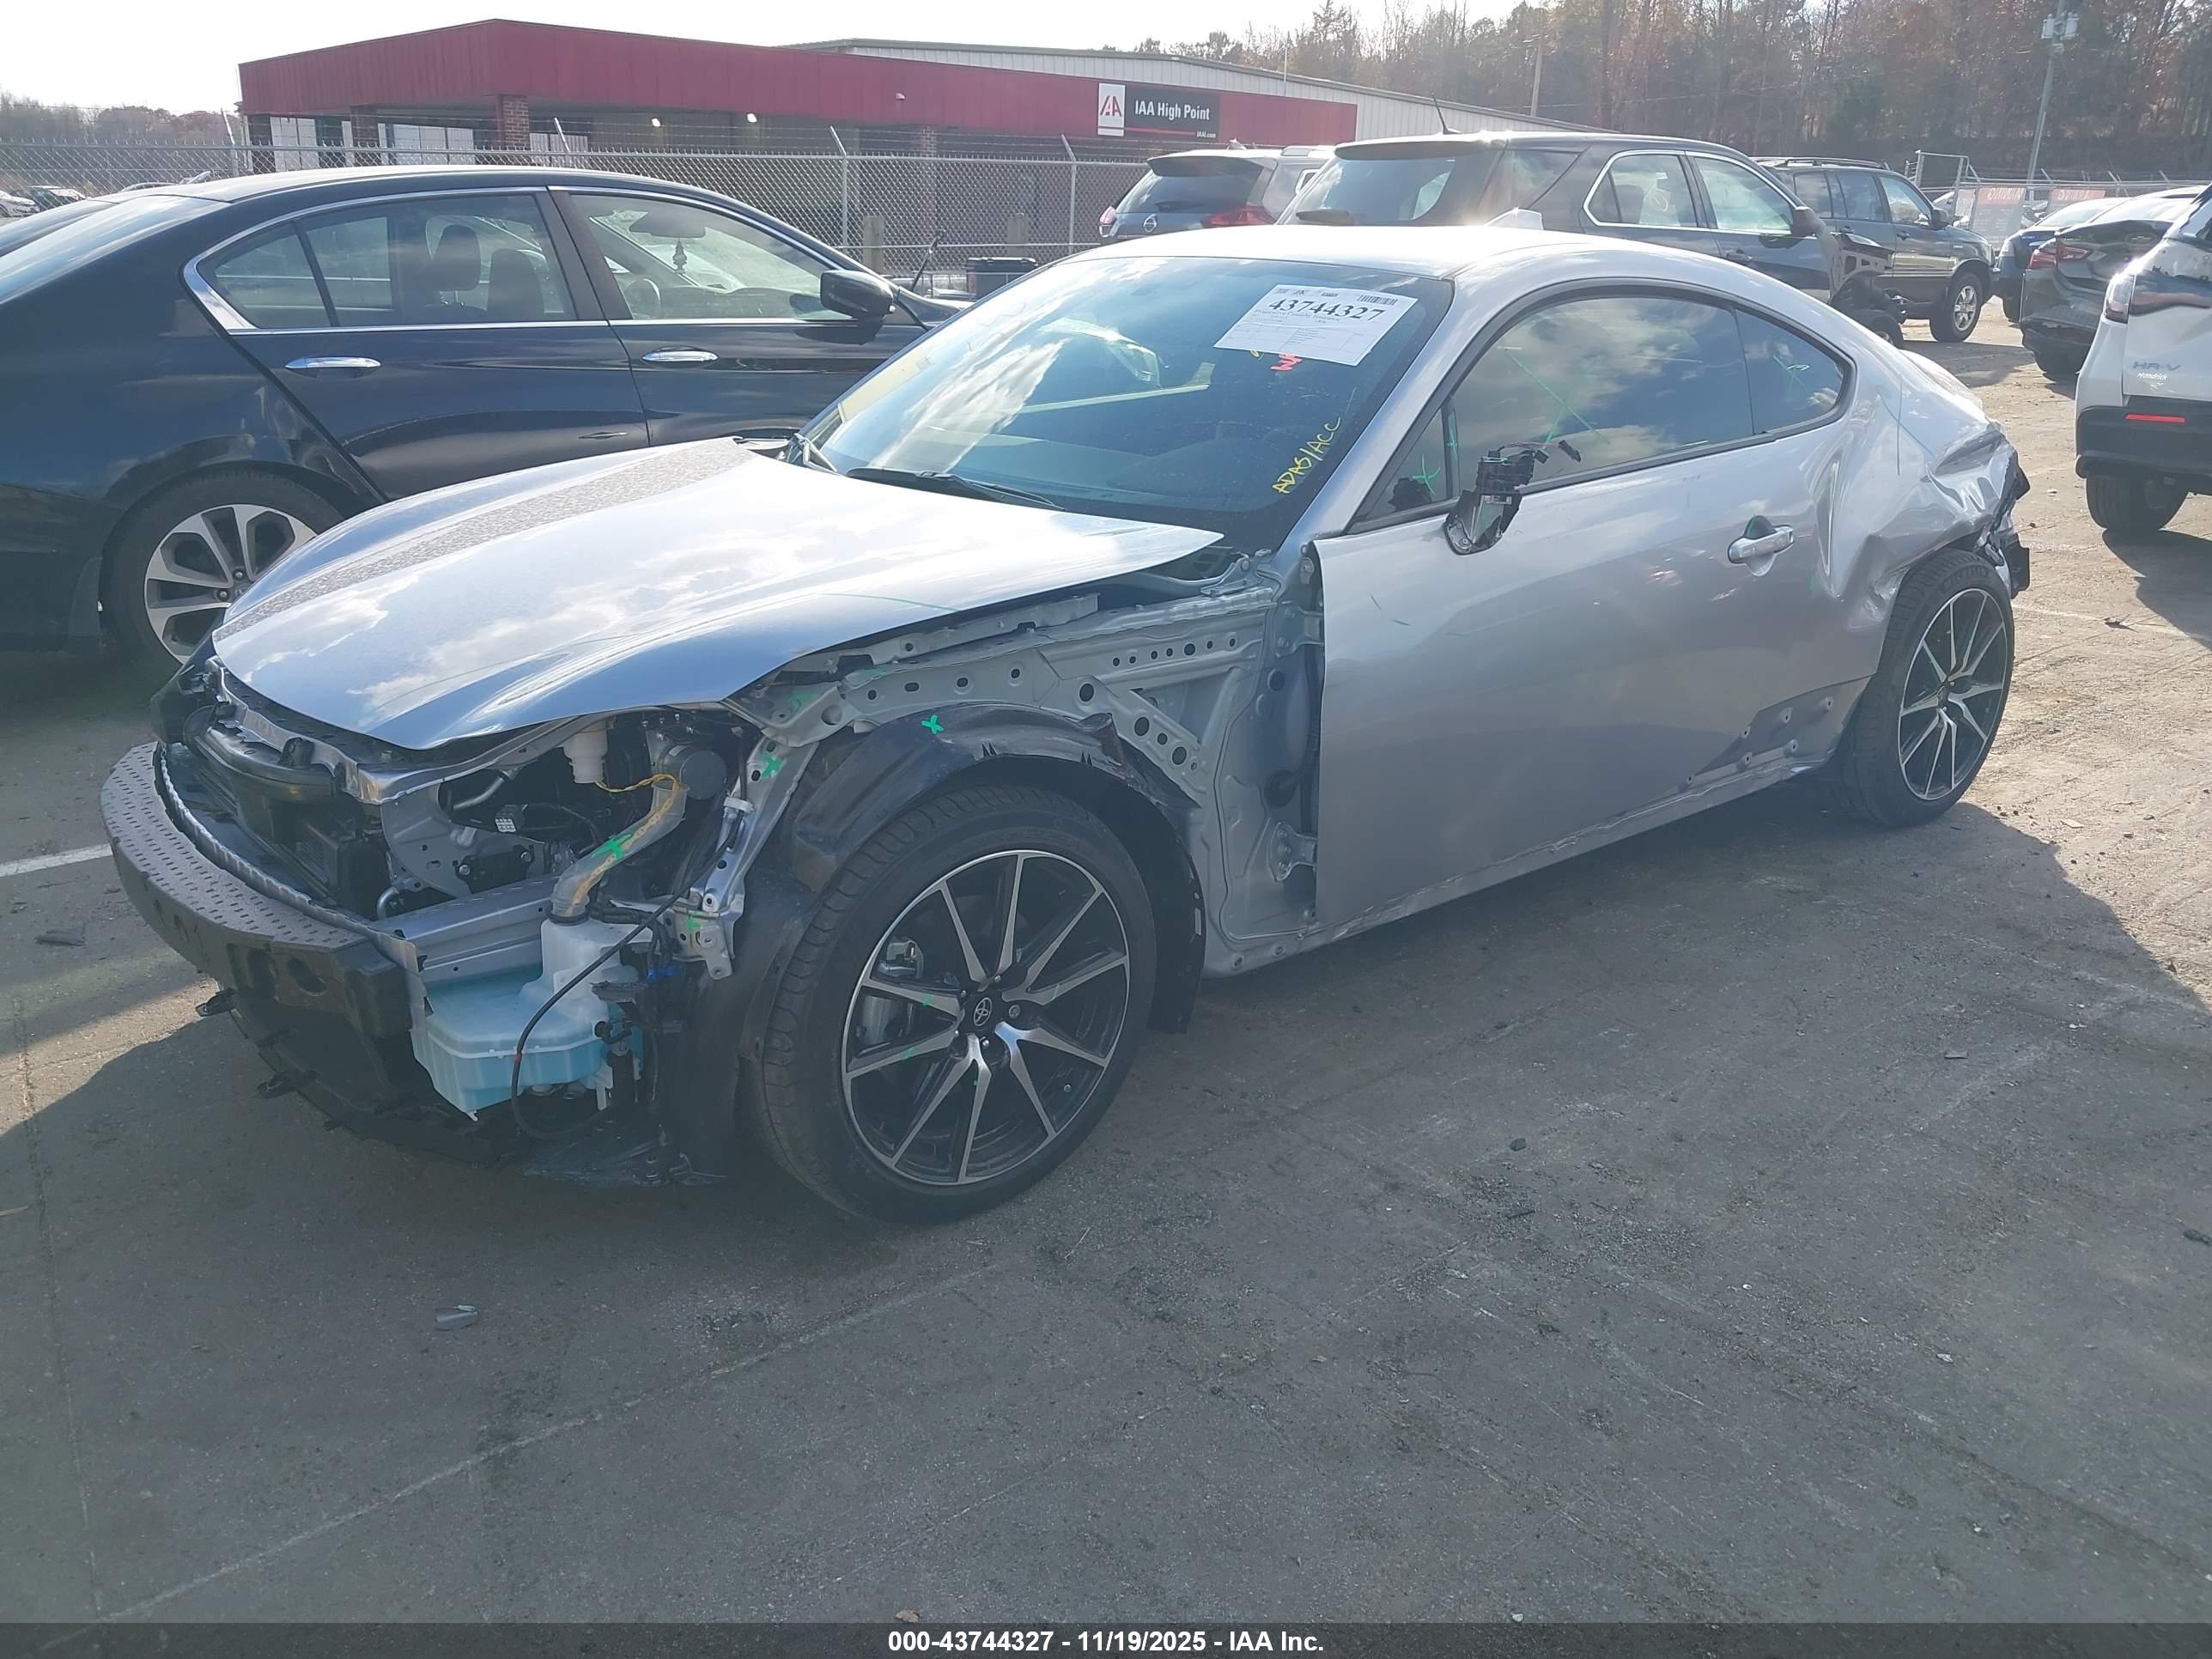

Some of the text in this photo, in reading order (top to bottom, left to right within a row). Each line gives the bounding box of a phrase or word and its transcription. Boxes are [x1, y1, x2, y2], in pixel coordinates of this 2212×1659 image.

[1134, 100, 1210, 121] IAA High Point
[1269, 299, 1386, 321] 43744327
[2133, 362, 2181, 371] HR-V
